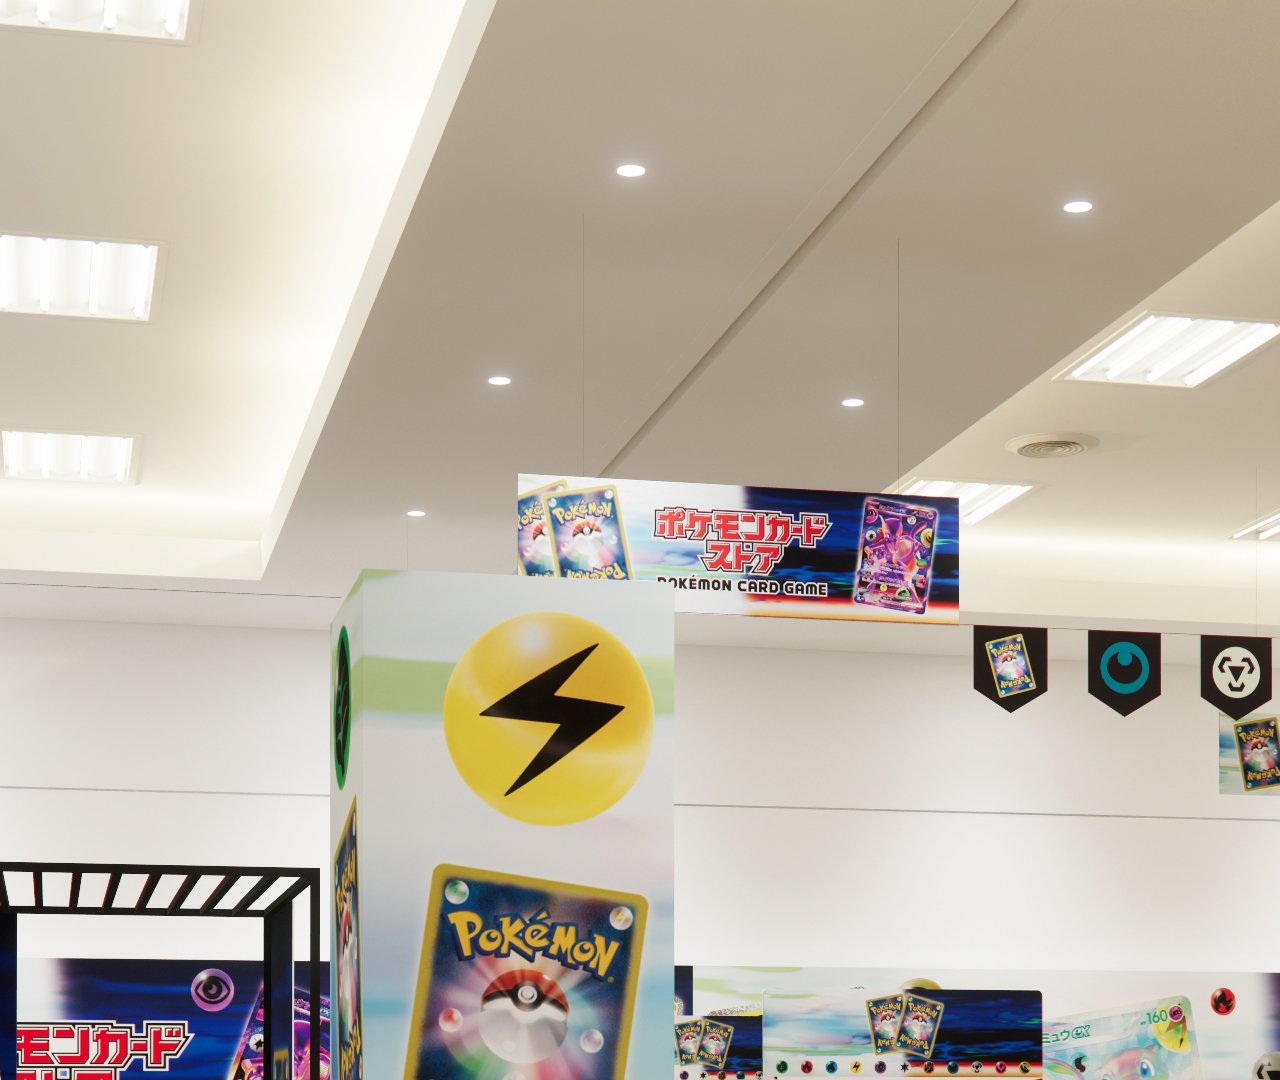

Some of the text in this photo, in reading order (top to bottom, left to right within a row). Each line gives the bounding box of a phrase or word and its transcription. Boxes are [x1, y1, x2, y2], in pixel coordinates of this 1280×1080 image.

[655, 510, 827, 546] ポケモンカード
[700, 542, 782, 574] ストア
[657, 575, 827, 596] OKÉMON CARD GAME
[1147, 1009, 1168, 1024] 160
